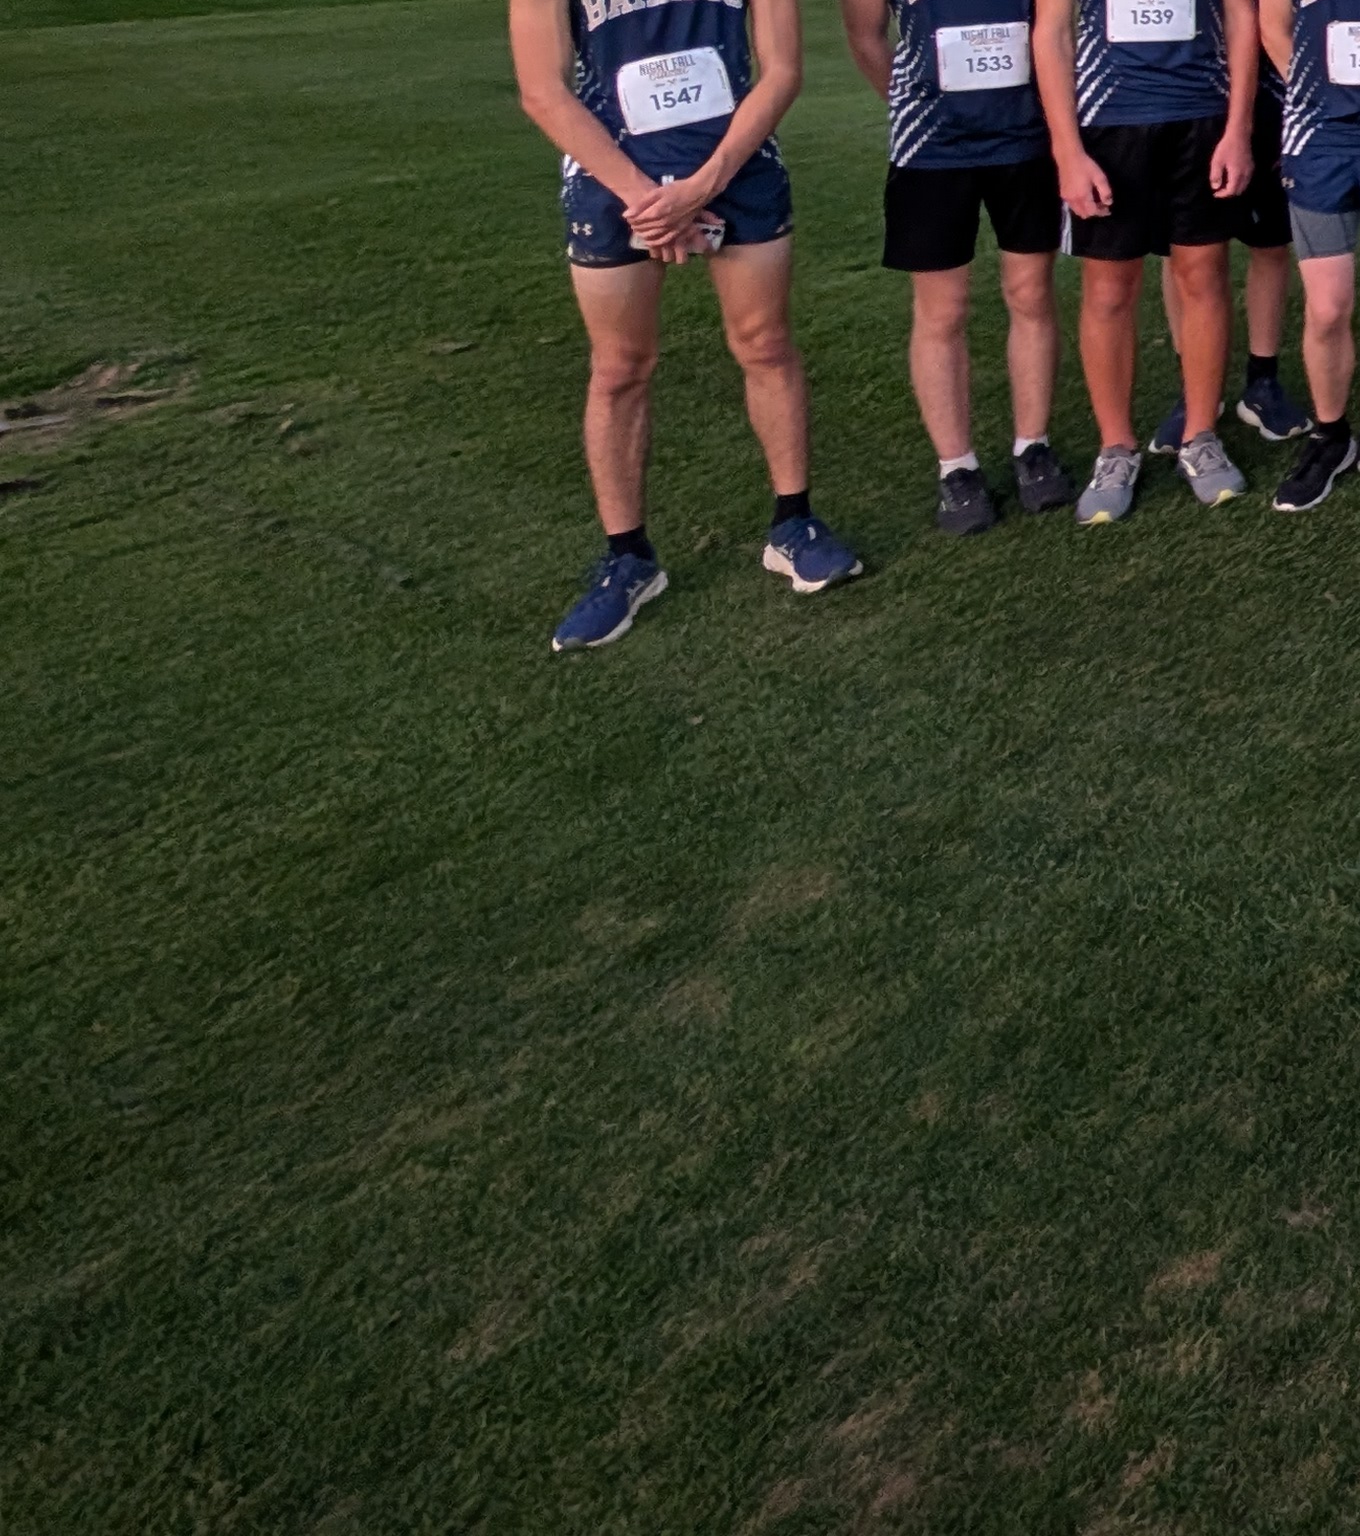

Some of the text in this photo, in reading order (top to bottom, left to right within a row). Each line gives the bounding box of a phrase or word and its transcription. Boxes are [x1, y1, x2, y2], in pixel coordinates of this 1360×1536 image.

[1131, 9, 1174, 25] 1539
[965, 55, 1014, 73] 1533
[650, 84, 702, 110] 1547
